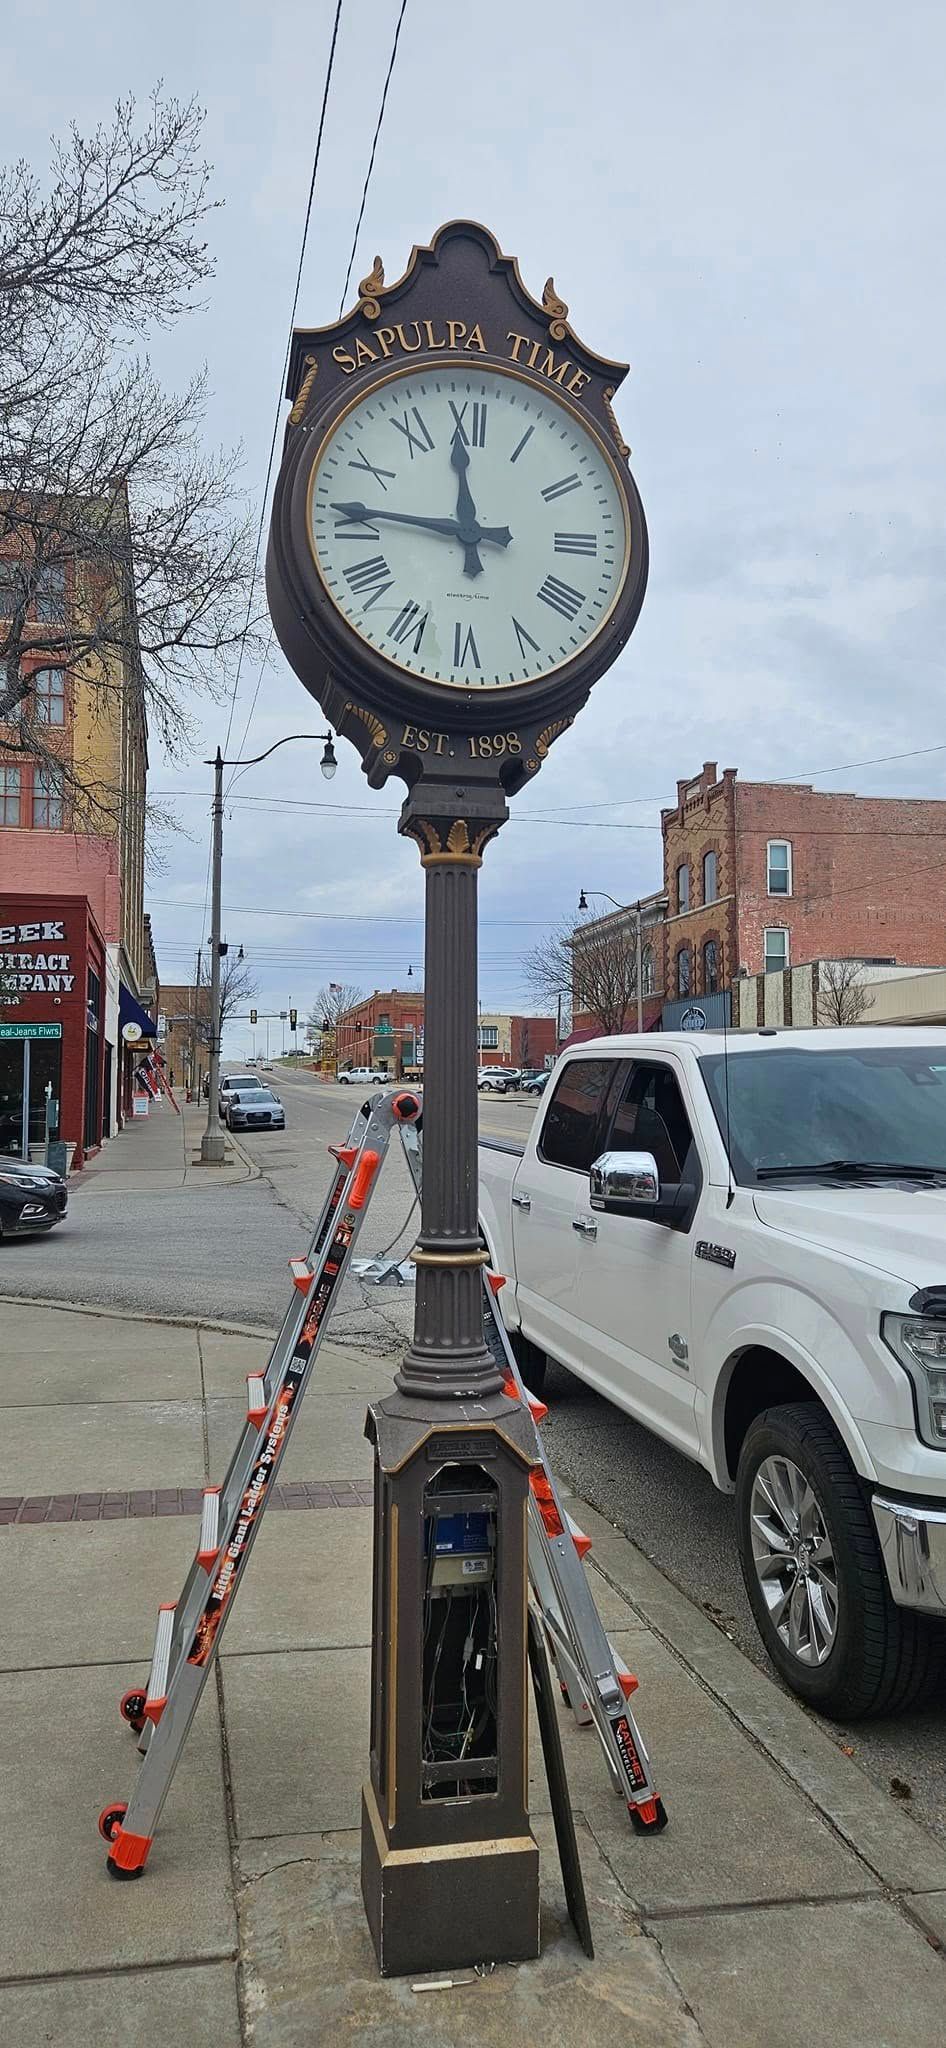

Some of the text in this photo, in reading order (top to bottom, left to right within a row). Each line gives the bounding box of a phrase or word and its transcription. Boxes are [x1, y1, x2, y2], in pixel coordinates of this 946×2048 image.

[332, 320, 593, 399] SAPULPA TIME
[388, 406, 436, 460] XI
[447, 400, 488, 448] XII
[509, 425, 536, 463] I
[347, 448, 397, 491] X
[540, 472, 583, 503] II
[554, 532, 597, 557] III
[342, 554, 396, 612] VIII
[385, 599, 429, 655] VII
[452, 622, 482, 669] VI
[511, 615, 541, 660] V
[400, 724, 522, 758] EST. 1898
[0, 921, 65, 944] EEK
[38, 1026, 59, 1036] Flwrs
[212, 1405, 289, 1601] Little Giant Ladder Systems
[618, 1719, 646, 1785] RATCHET
[619, 1742, 637, 1786] LEVELERS
